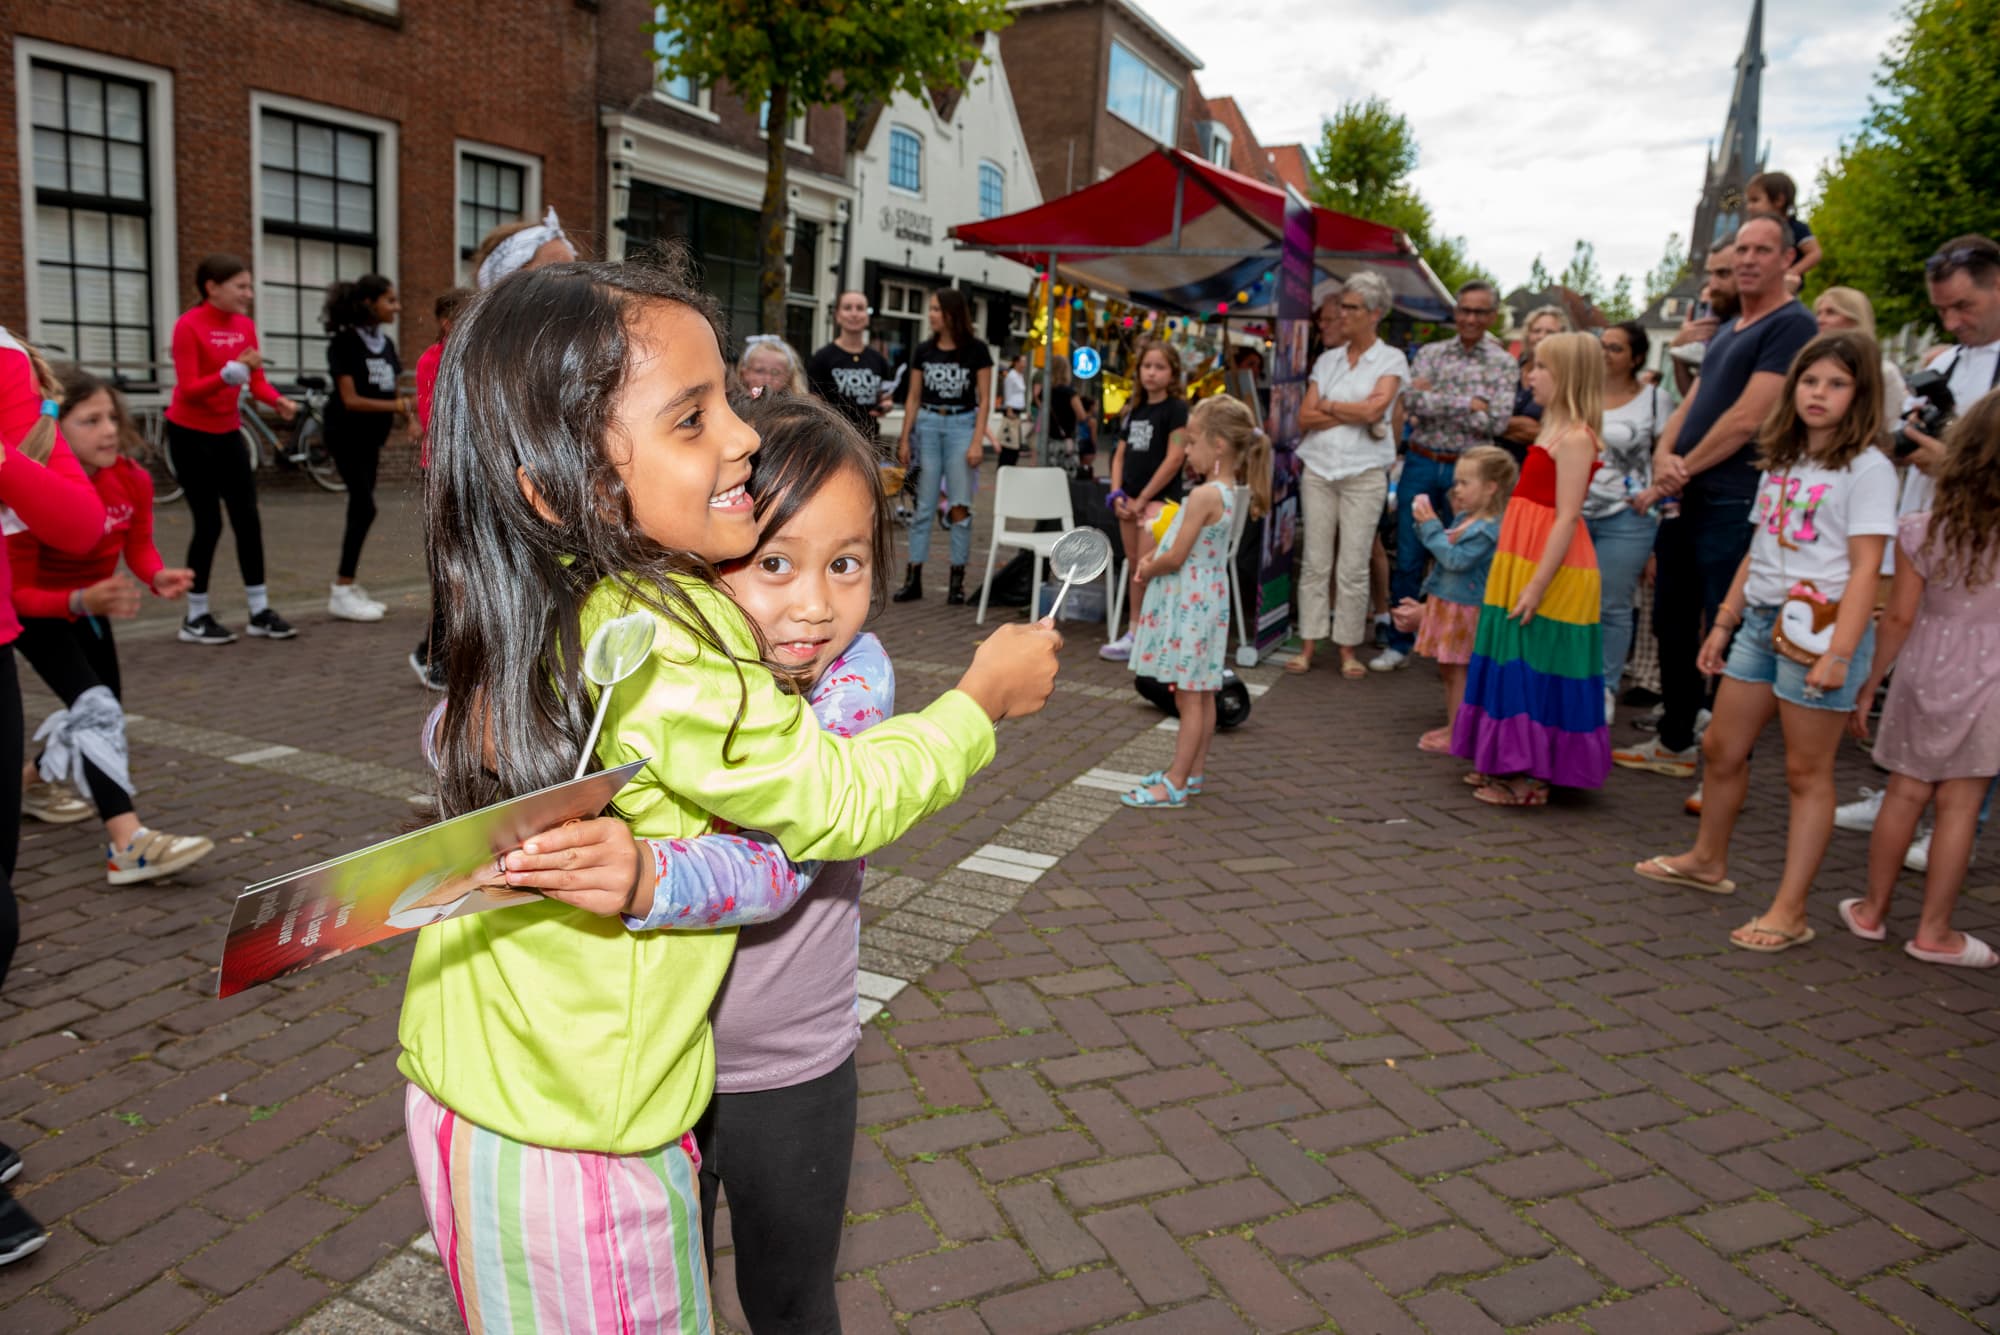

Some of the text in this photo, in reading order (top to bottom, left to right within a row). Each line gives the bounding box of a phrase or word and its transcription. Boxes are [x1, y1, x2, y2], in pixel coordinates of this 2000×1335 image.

[896, 208, 932, 235] STOUTE
[833, 374, 881, 393] your
[923, 367, 970, 388] your
[278, 911, 302, 946] nieuwe
[301, 915, 328, 947] langs
